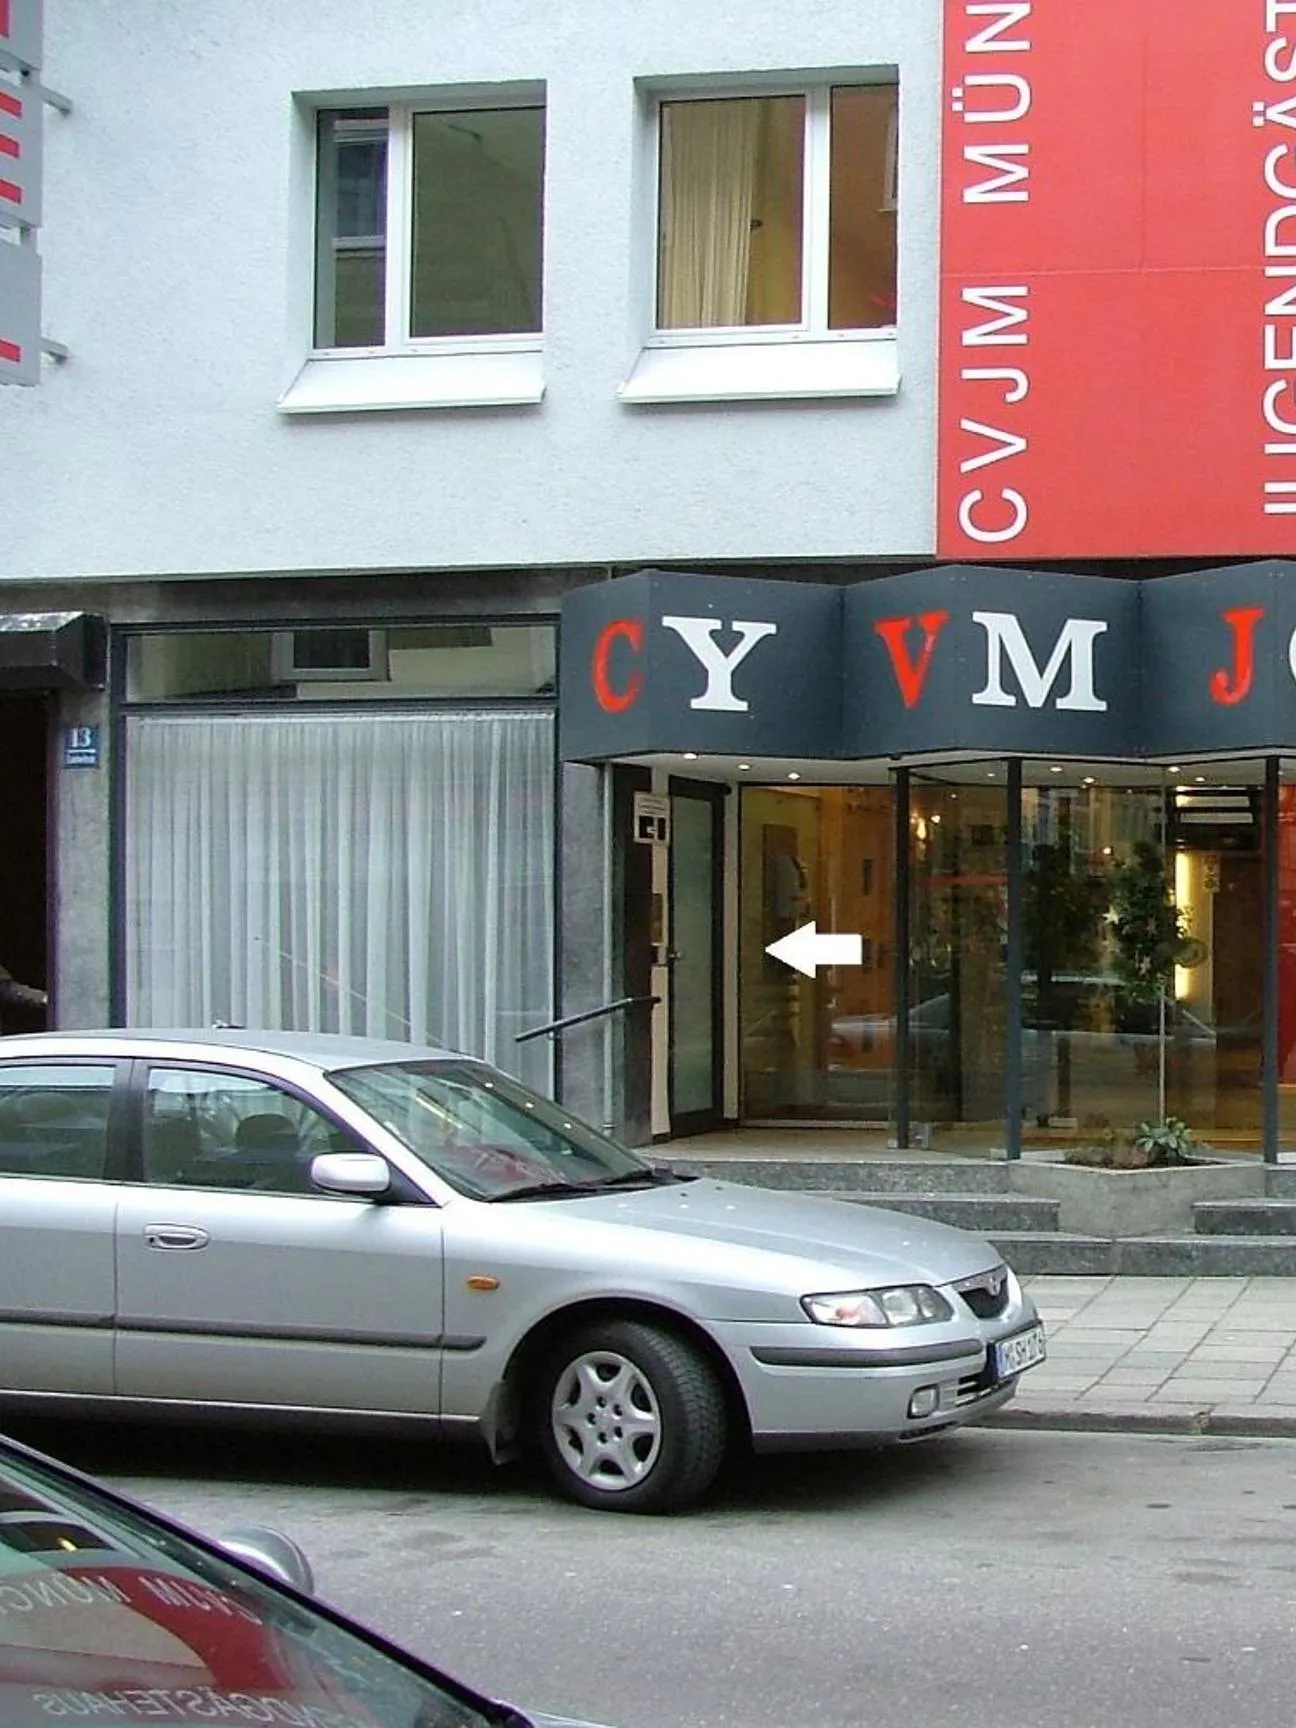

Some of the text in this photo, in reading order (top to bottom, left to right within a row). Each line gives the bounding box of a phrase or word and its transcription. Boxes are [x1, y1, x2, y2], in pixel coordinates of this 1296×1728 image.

[951, 2, 1032, 543] CVJM MÜN
[70, 727, 92, 747] 13
